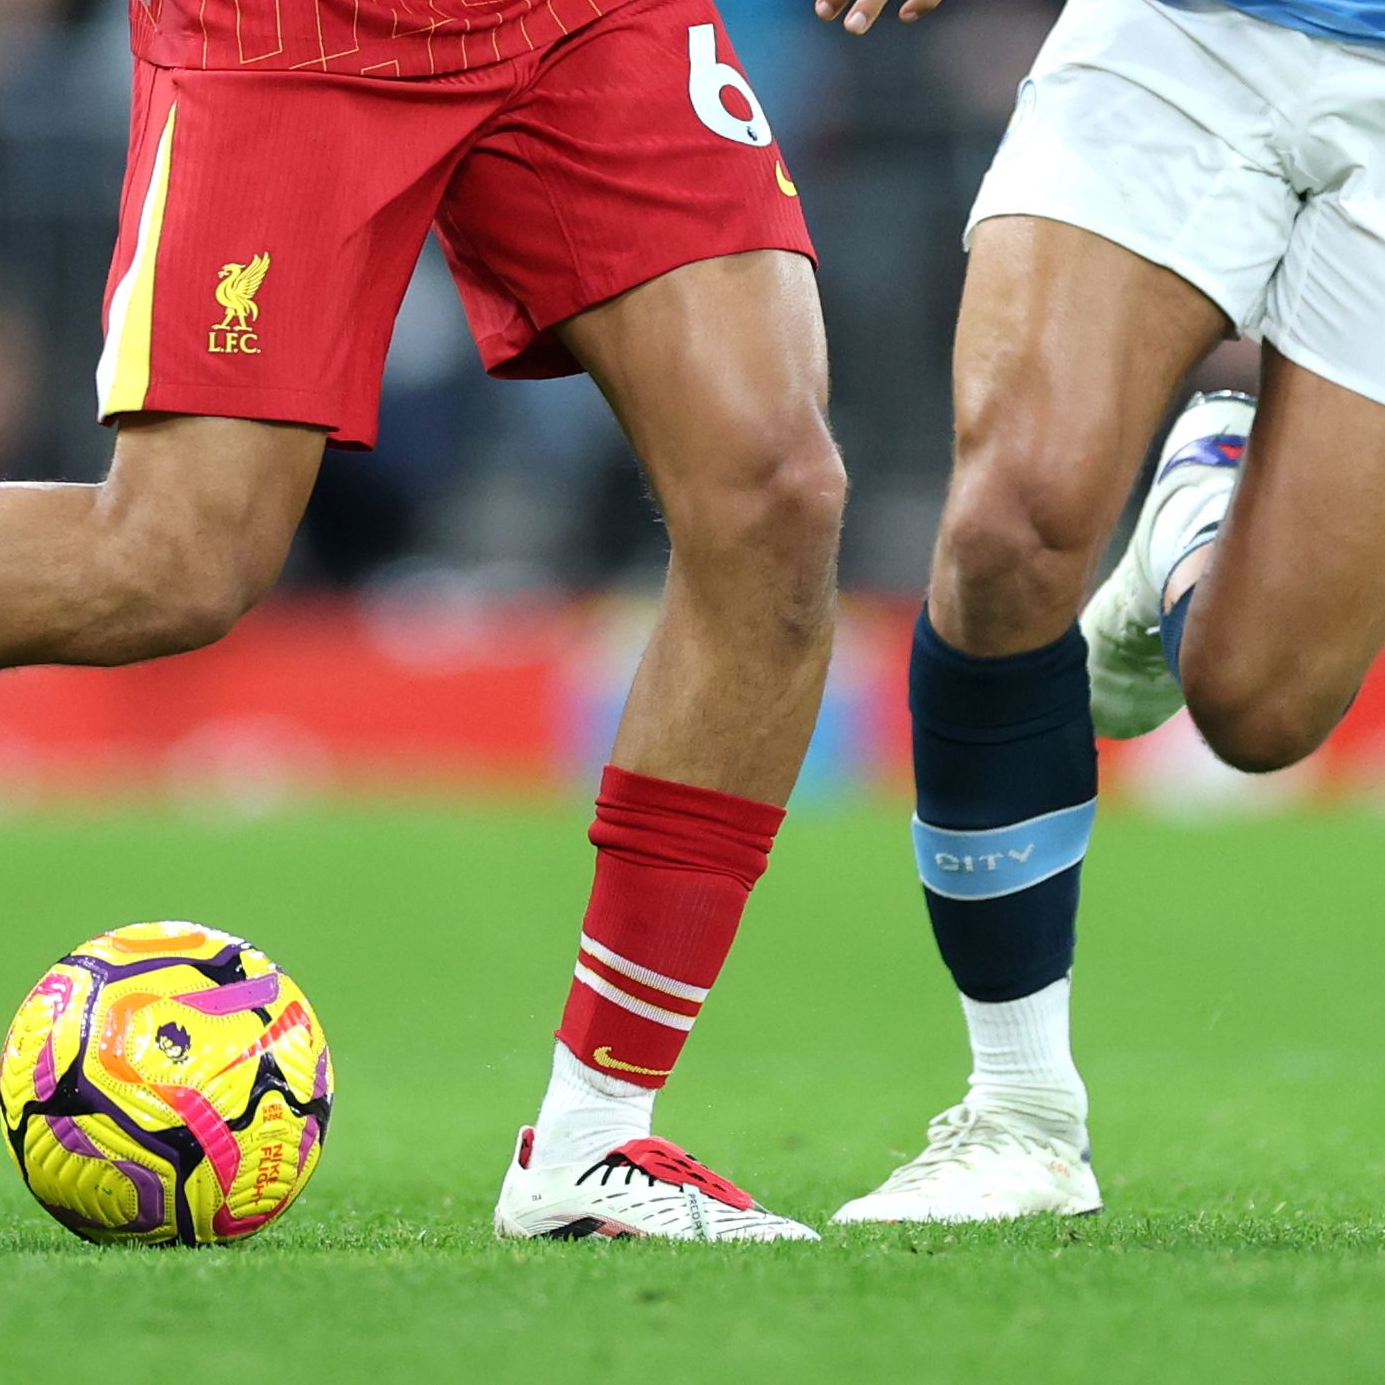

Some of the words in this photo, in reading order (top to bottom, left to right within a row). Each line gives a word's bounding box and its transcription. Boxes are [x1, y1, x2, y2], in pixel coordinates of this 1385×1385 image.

[688, 23, 773, 137] 6
[207, 331, 262, 354] L.F.C.
[934, 843, 1035, 872] CITY
[252, 1145, 272, 1206] FLIGHT
[267, 1143, 283, 1184] NIKE
